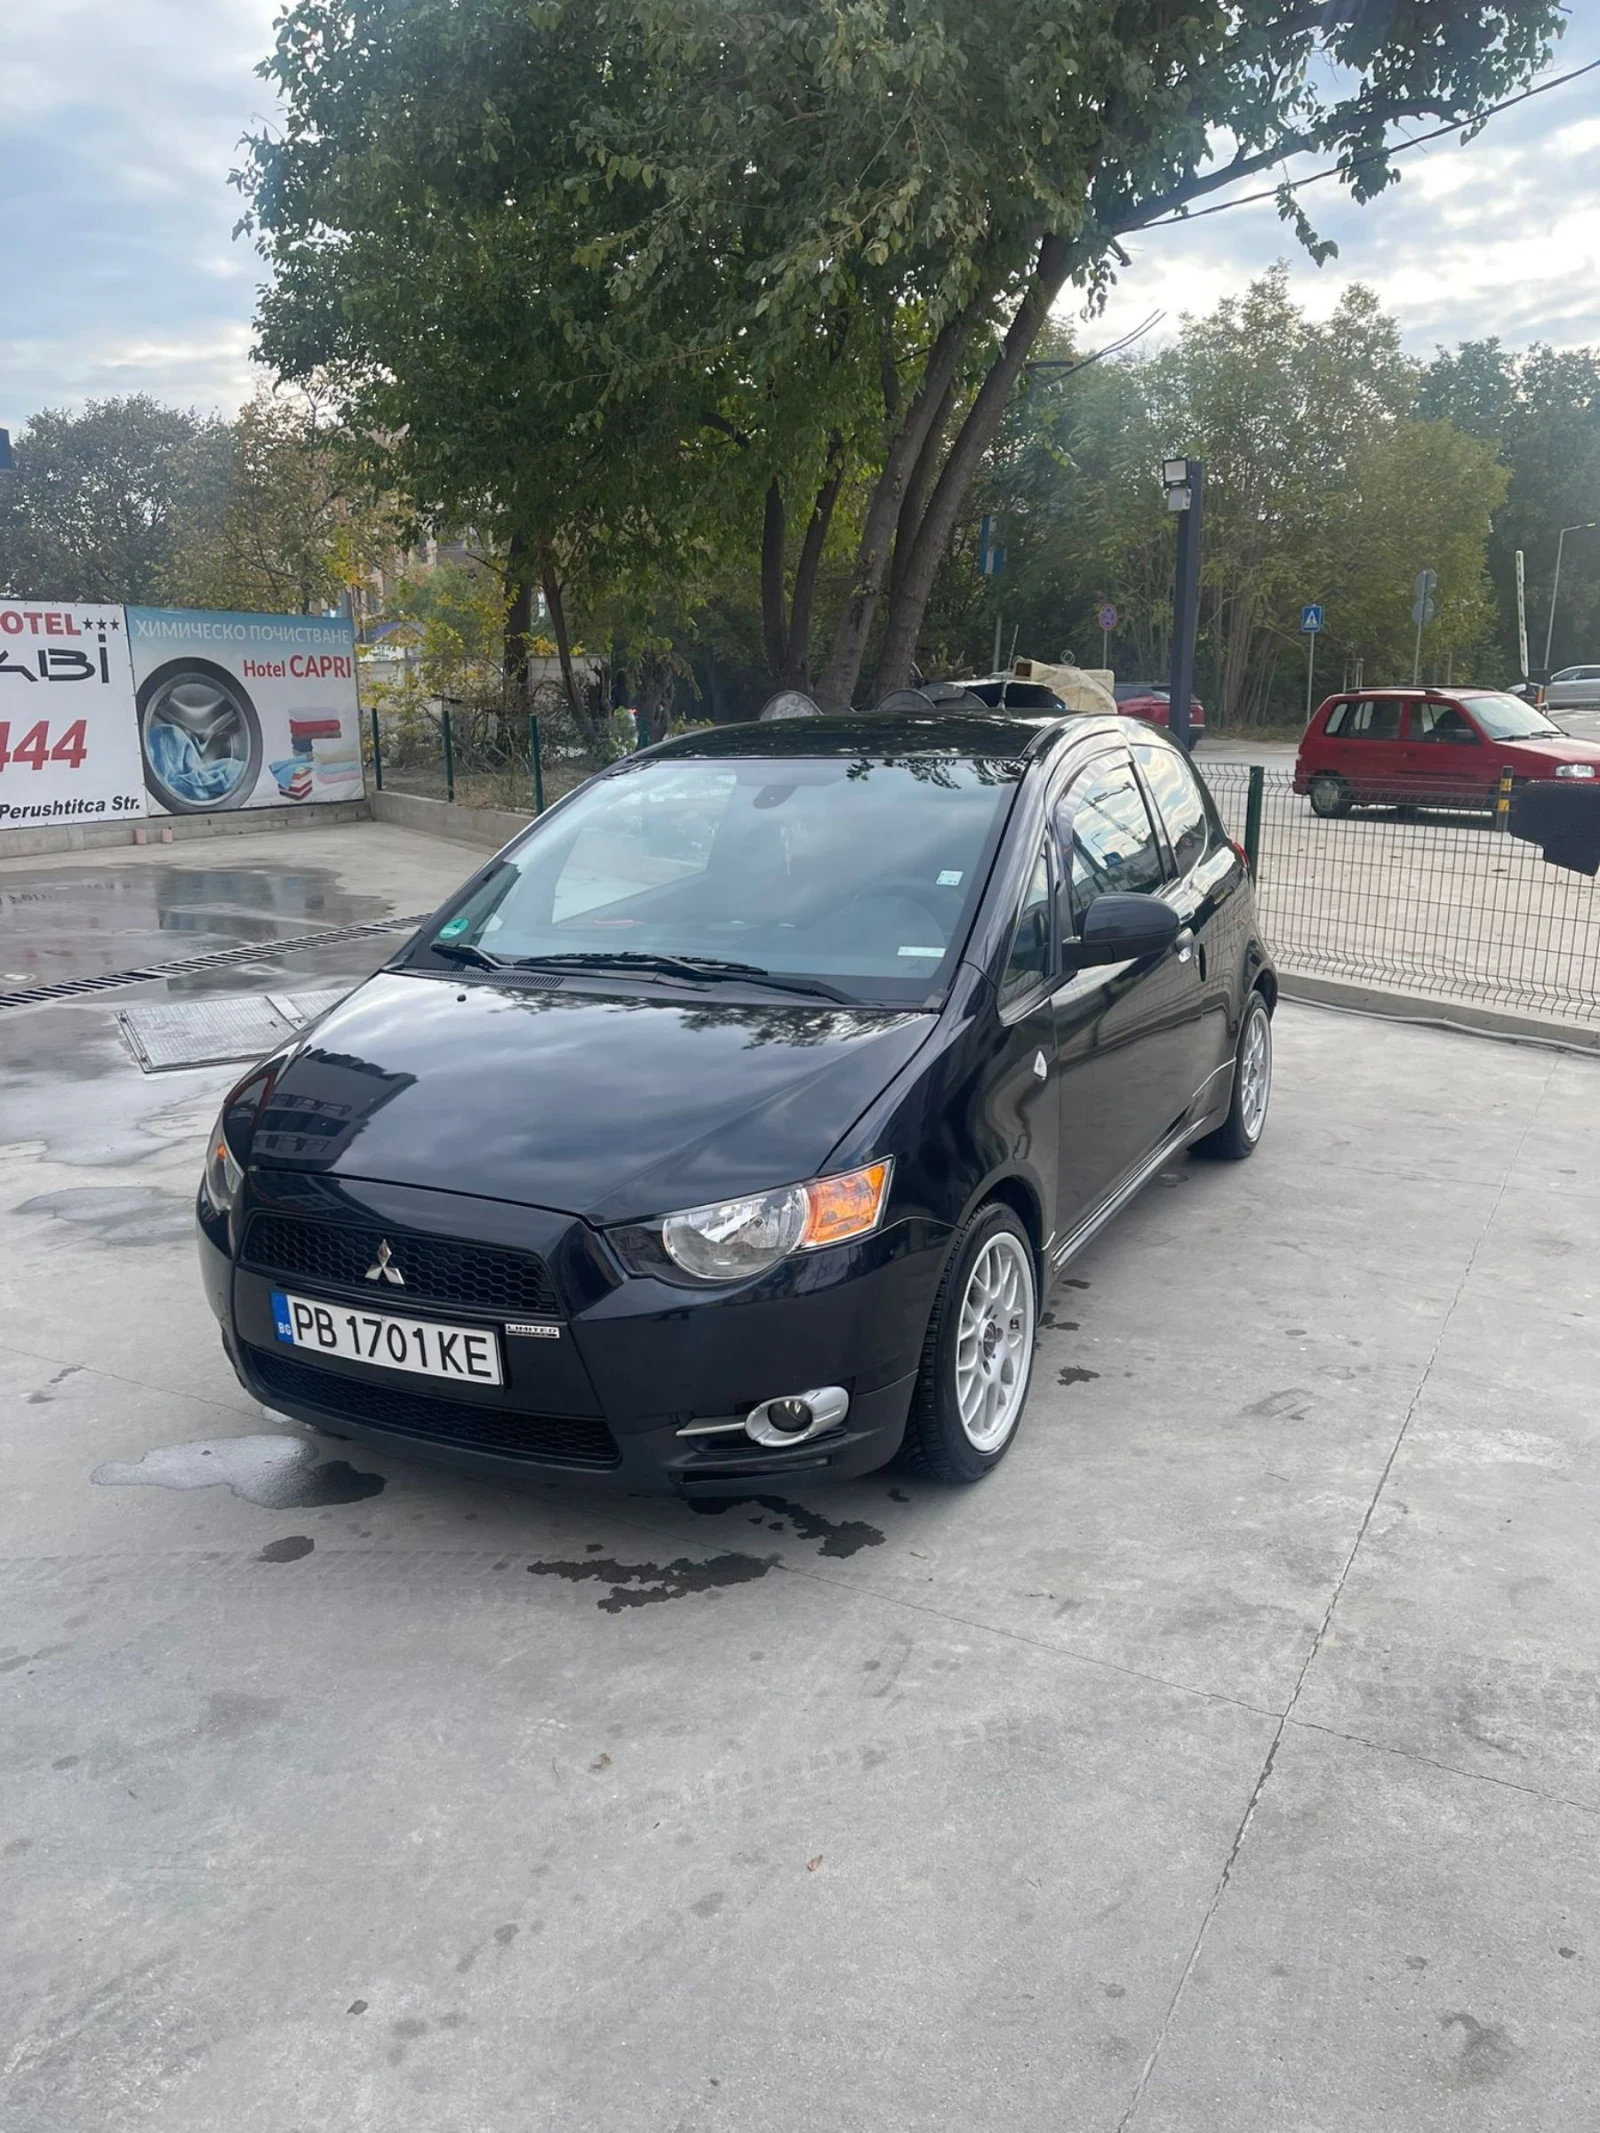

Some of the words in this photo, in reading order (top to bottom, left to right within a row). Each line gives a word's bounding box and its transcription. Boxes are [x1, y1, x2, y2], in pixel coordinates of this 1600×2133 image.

[136, 619, 246, 641] ХИМИЧЕСКО
[250, 625, 350, 645] ПОЧИСТВАНЕ
[243, 659, 286, 678] Hotel
[289, 654, 351, 679] CAPRI
[0, 798, 106, 819] Perushtitca
[111, 795, 140, 811] Str.
[278, 1321, 292, 1336] BG
[293, 1302, 337, 1348] PB
[346, 1315, 428, 1368] 1701
[438, 1330, 492, 1378] KE
